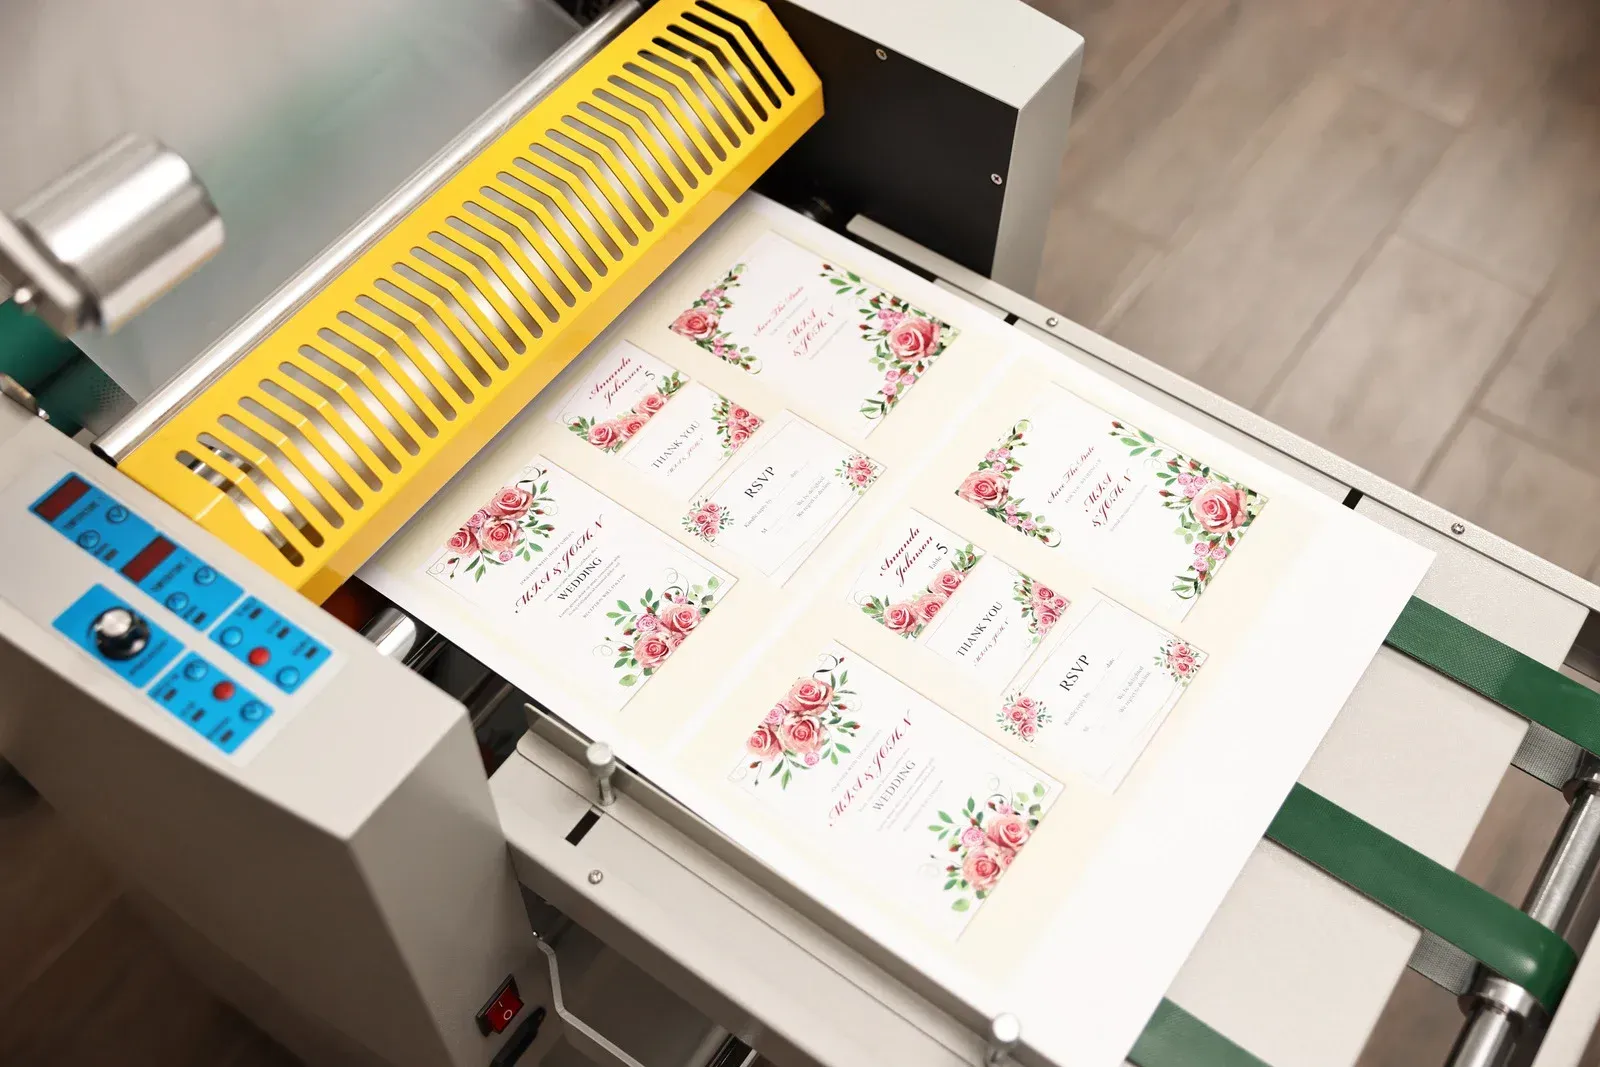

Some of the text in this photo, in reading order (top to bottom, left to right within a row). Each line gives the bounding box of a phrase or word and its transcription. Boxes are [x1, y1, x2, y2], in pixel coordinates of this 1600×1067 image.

[787, 309, 816, 344] MIA
[590, 357, 631, 399] Amanda
[604, 366, 642, 409] Johnson
[644, 370, 655, 381] 5
[651, 420, 700, 468] THANK YOU
[744, 465, 775, 499] RSVP
[1049, 446, 1095, 503] Save The Date
[1084, 472, 1112, 512] MIA
[1099, 468, 1131, 525] JOHN
[515, 571, 549, 613] MIA
[563, 514, 602, 573] JOHN
[881, 528, 920, 576] Amanda
[895, 537, 933, 587] Johnson
[929, 543, 947, 570] Table 5
[558, 557, 602, 599] WEDDING
[956, 601, 1003, 656] THANK YOU
[1059, 654, 1089, 691] RSVP
[1106, 658, 1115, 669] date
[827, 776, 862, 826] MIA
[875, 709, 914, 776] JOHN
[873, 759, 916, 810] WEDDING
